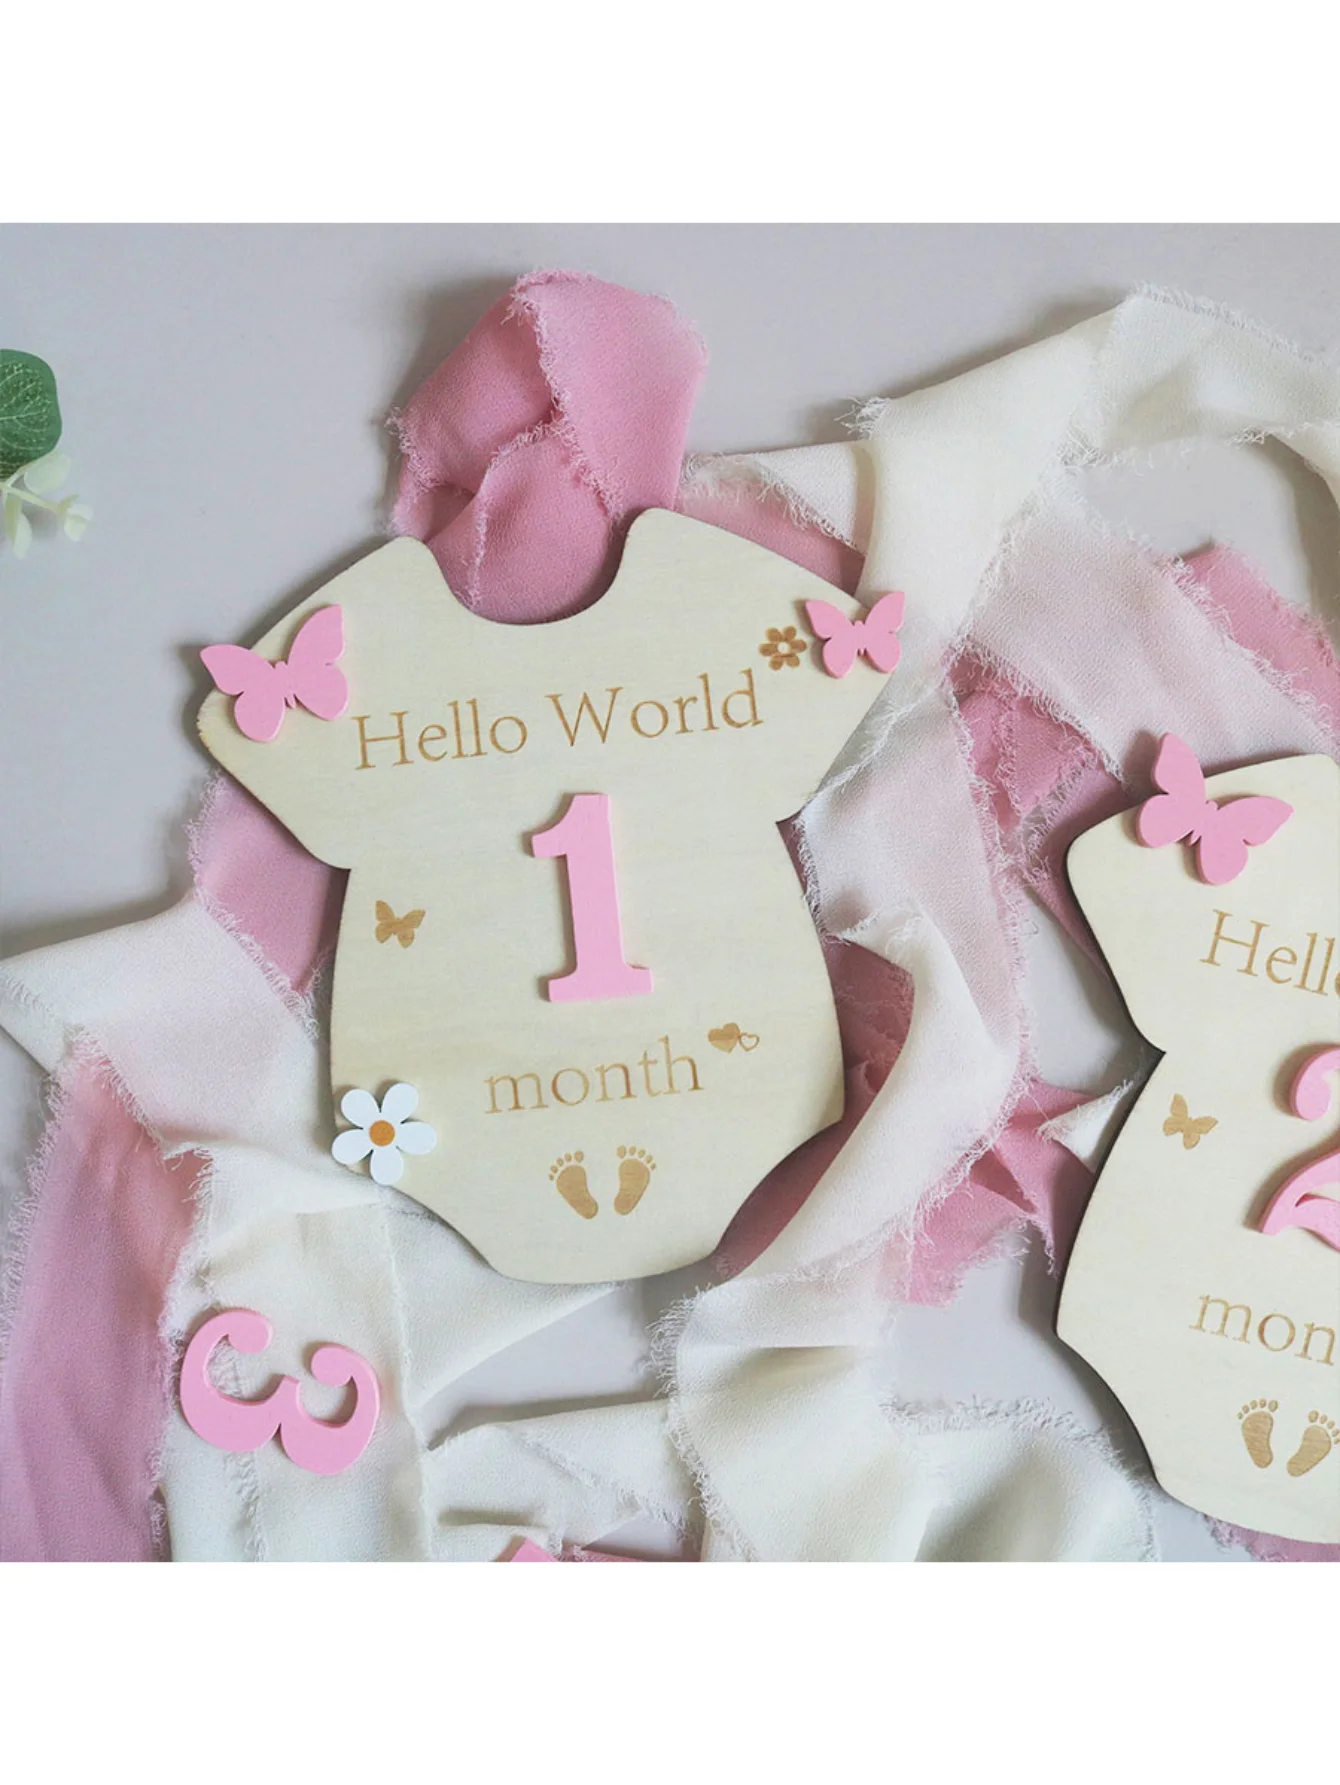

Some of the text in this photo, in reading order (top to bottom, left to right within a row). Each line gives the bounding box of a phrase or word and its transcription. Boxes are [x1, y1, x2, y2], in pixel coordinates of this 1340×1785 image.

[353, 668, 765, 770] Hello World
[530, 792, 654, 1002] 1
[1199, 908, 1340, 1000] Hell
[483, 1035, 703, 1115] month
[180, 1307, 381, 1476] 3
